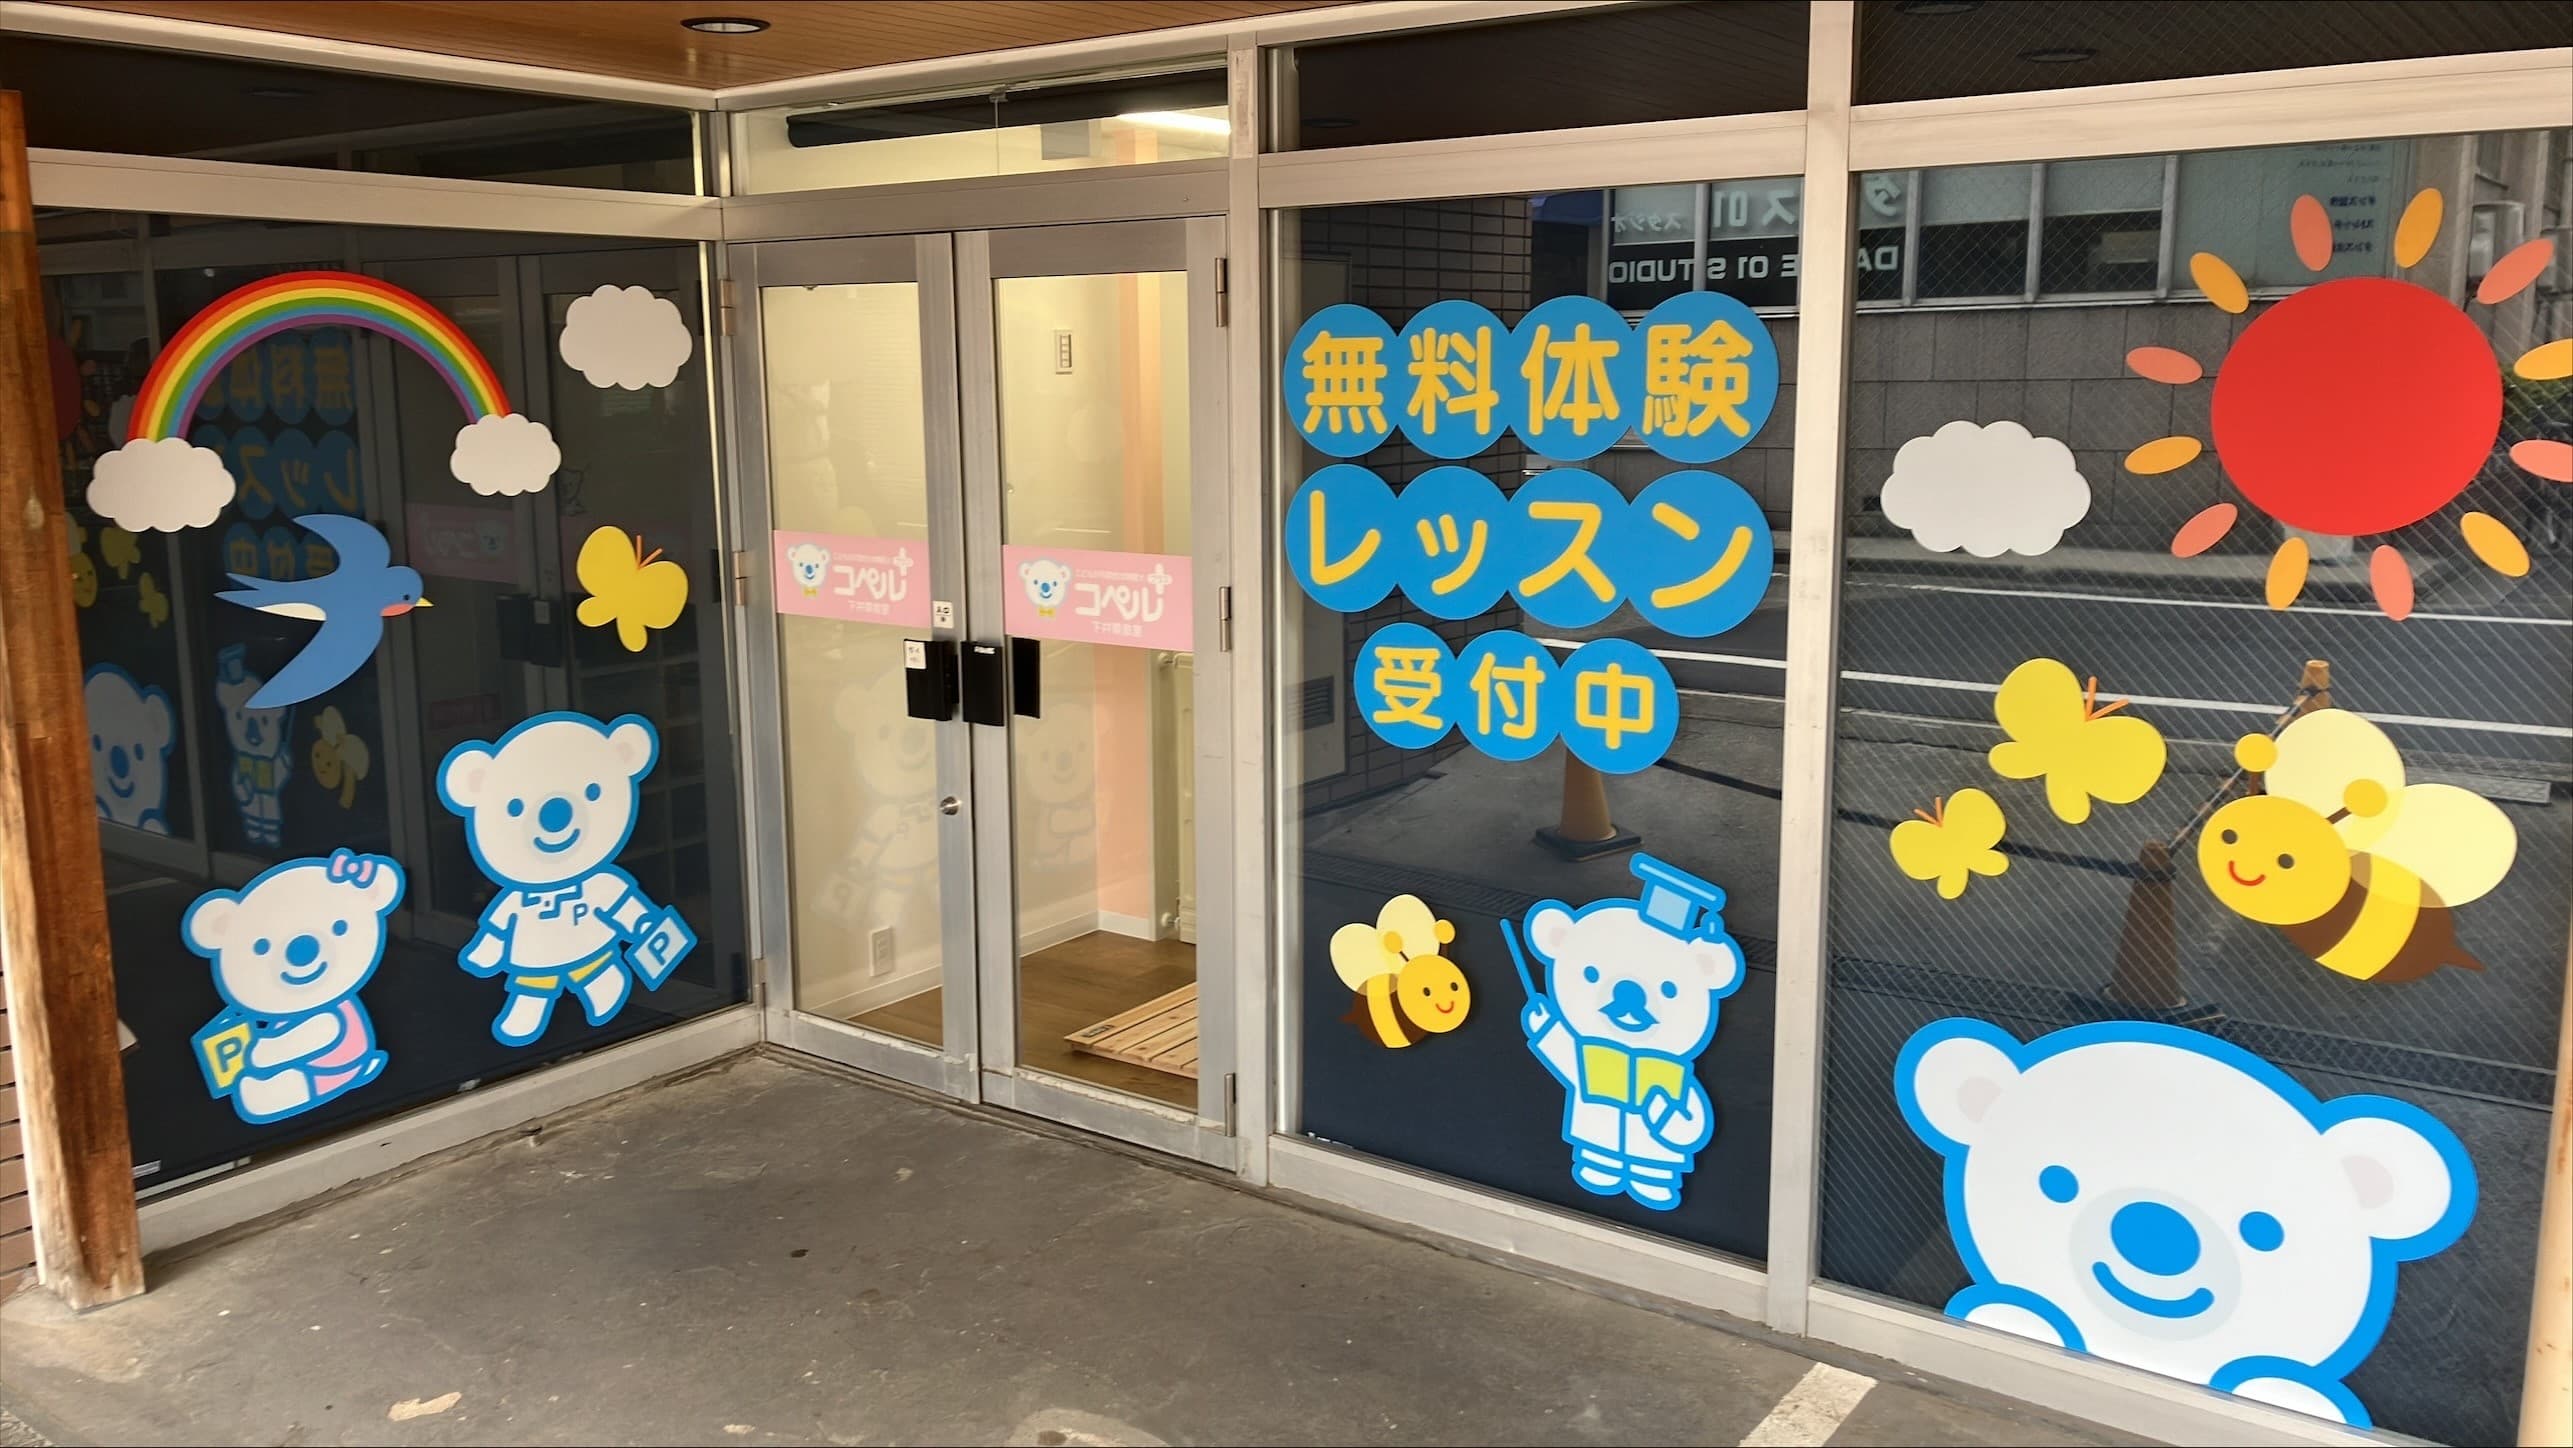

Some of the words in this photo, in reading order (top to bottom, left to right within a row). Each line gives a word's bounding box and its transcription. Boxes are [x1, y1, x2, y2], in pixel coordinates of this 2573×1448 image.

[1302, 320, 1753, 438] 無料体験
[1309, 489, 1753, 609] レッスン
[1373, 647, 1654, 750] 受付中
[573, 903, 588, 926] P
[648, 932, 669, 965] P
[216, 1037, 242, 1073] P
